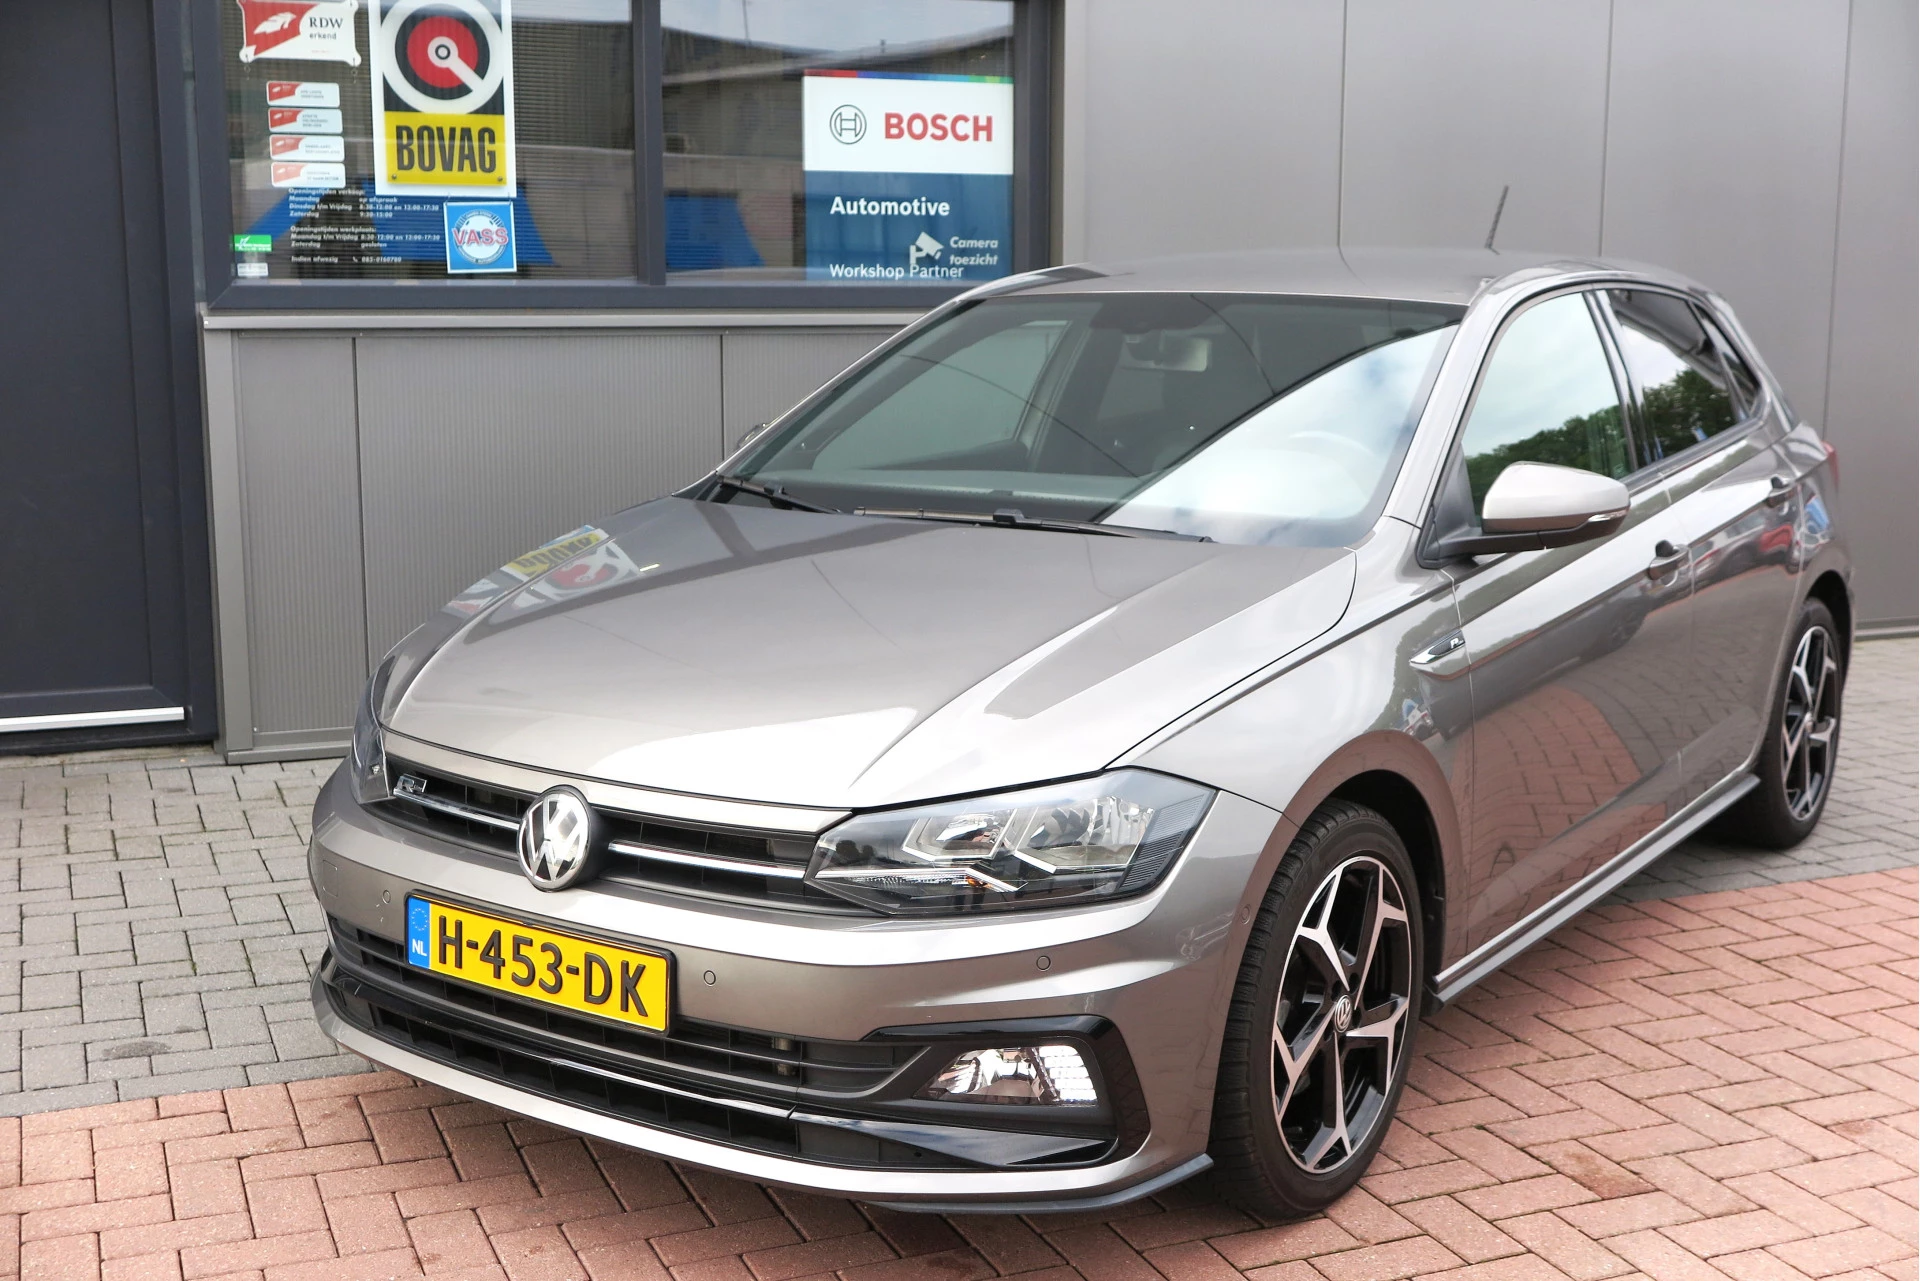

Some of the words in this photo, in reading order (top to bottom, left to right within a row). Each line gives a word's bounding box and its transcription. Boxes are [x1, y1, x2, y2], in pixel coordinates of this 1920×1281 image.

[308, 17, 344, 28] RDW
[884, 112, 993, 142] BOSCH
[395, 125, 497, 174] BOVAG
[288, 187, 336, 196] Openingstijden
[329, 204, 352, 212] Vrijdag
[830, 196, 950, 216] Automotive
[290, 225, 338, 234] Openingstijden
[290, 233, 322, 241] Maandag
[336, 234, 358, 242] Vrijdag
[452, 227, 508, 246] VASS
[950, 236, 998, 249] Camera
[291, 240, 321, 248] Zaterdag
[360, 241, 388, 249] gesloten
[949, 253, 998, 266] toezicht
[829, 264, 905, 280] Workshop
[909, 263, 965, 278] Partner
[412, 939, 428, 957] NL
[438, 914, 649, 1017] H-453-DK
